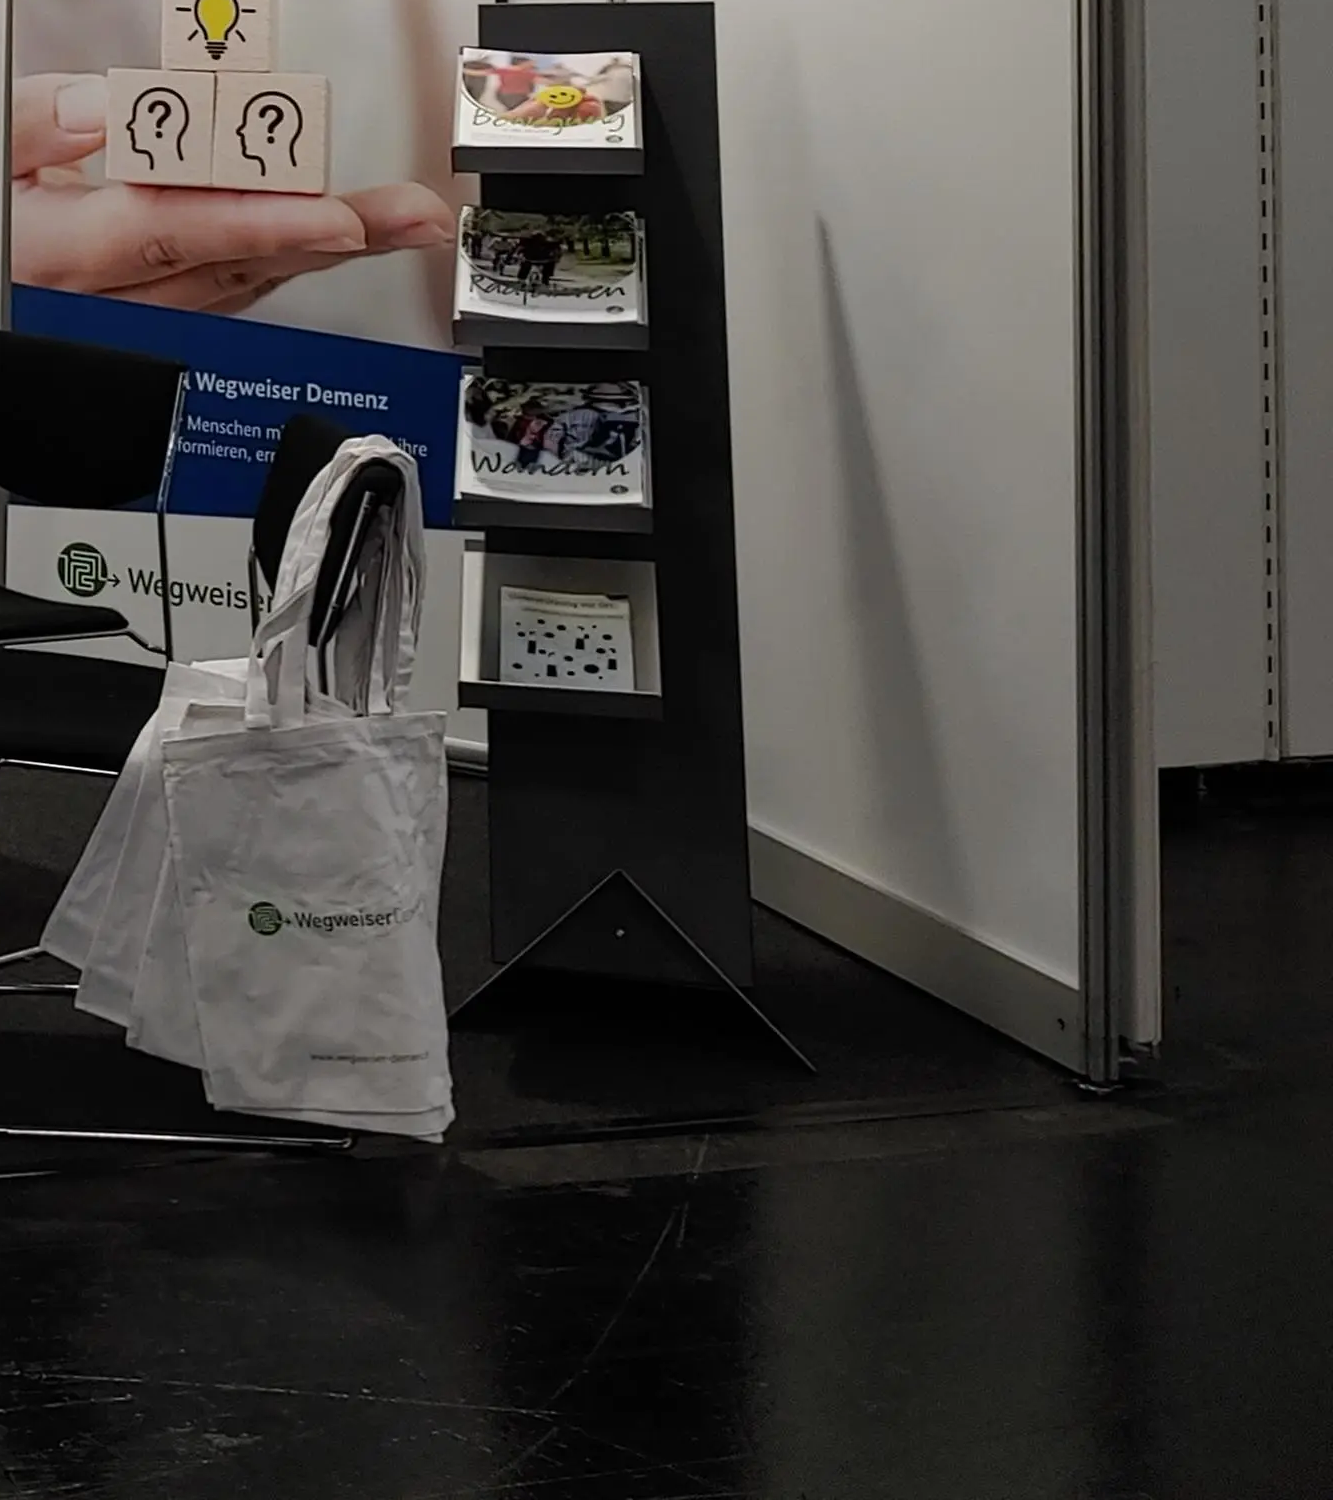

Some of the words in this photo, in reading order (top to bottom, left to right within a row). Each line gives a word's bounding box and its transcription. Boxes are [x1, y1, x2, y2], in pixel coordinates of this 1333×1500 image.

[195, 371, 301, 401] Wegweiser
[307, 383, 389, 411] Demenz
[186, 414, 261, 440] Menschen
[177, 436, 252, 463] formieren,
